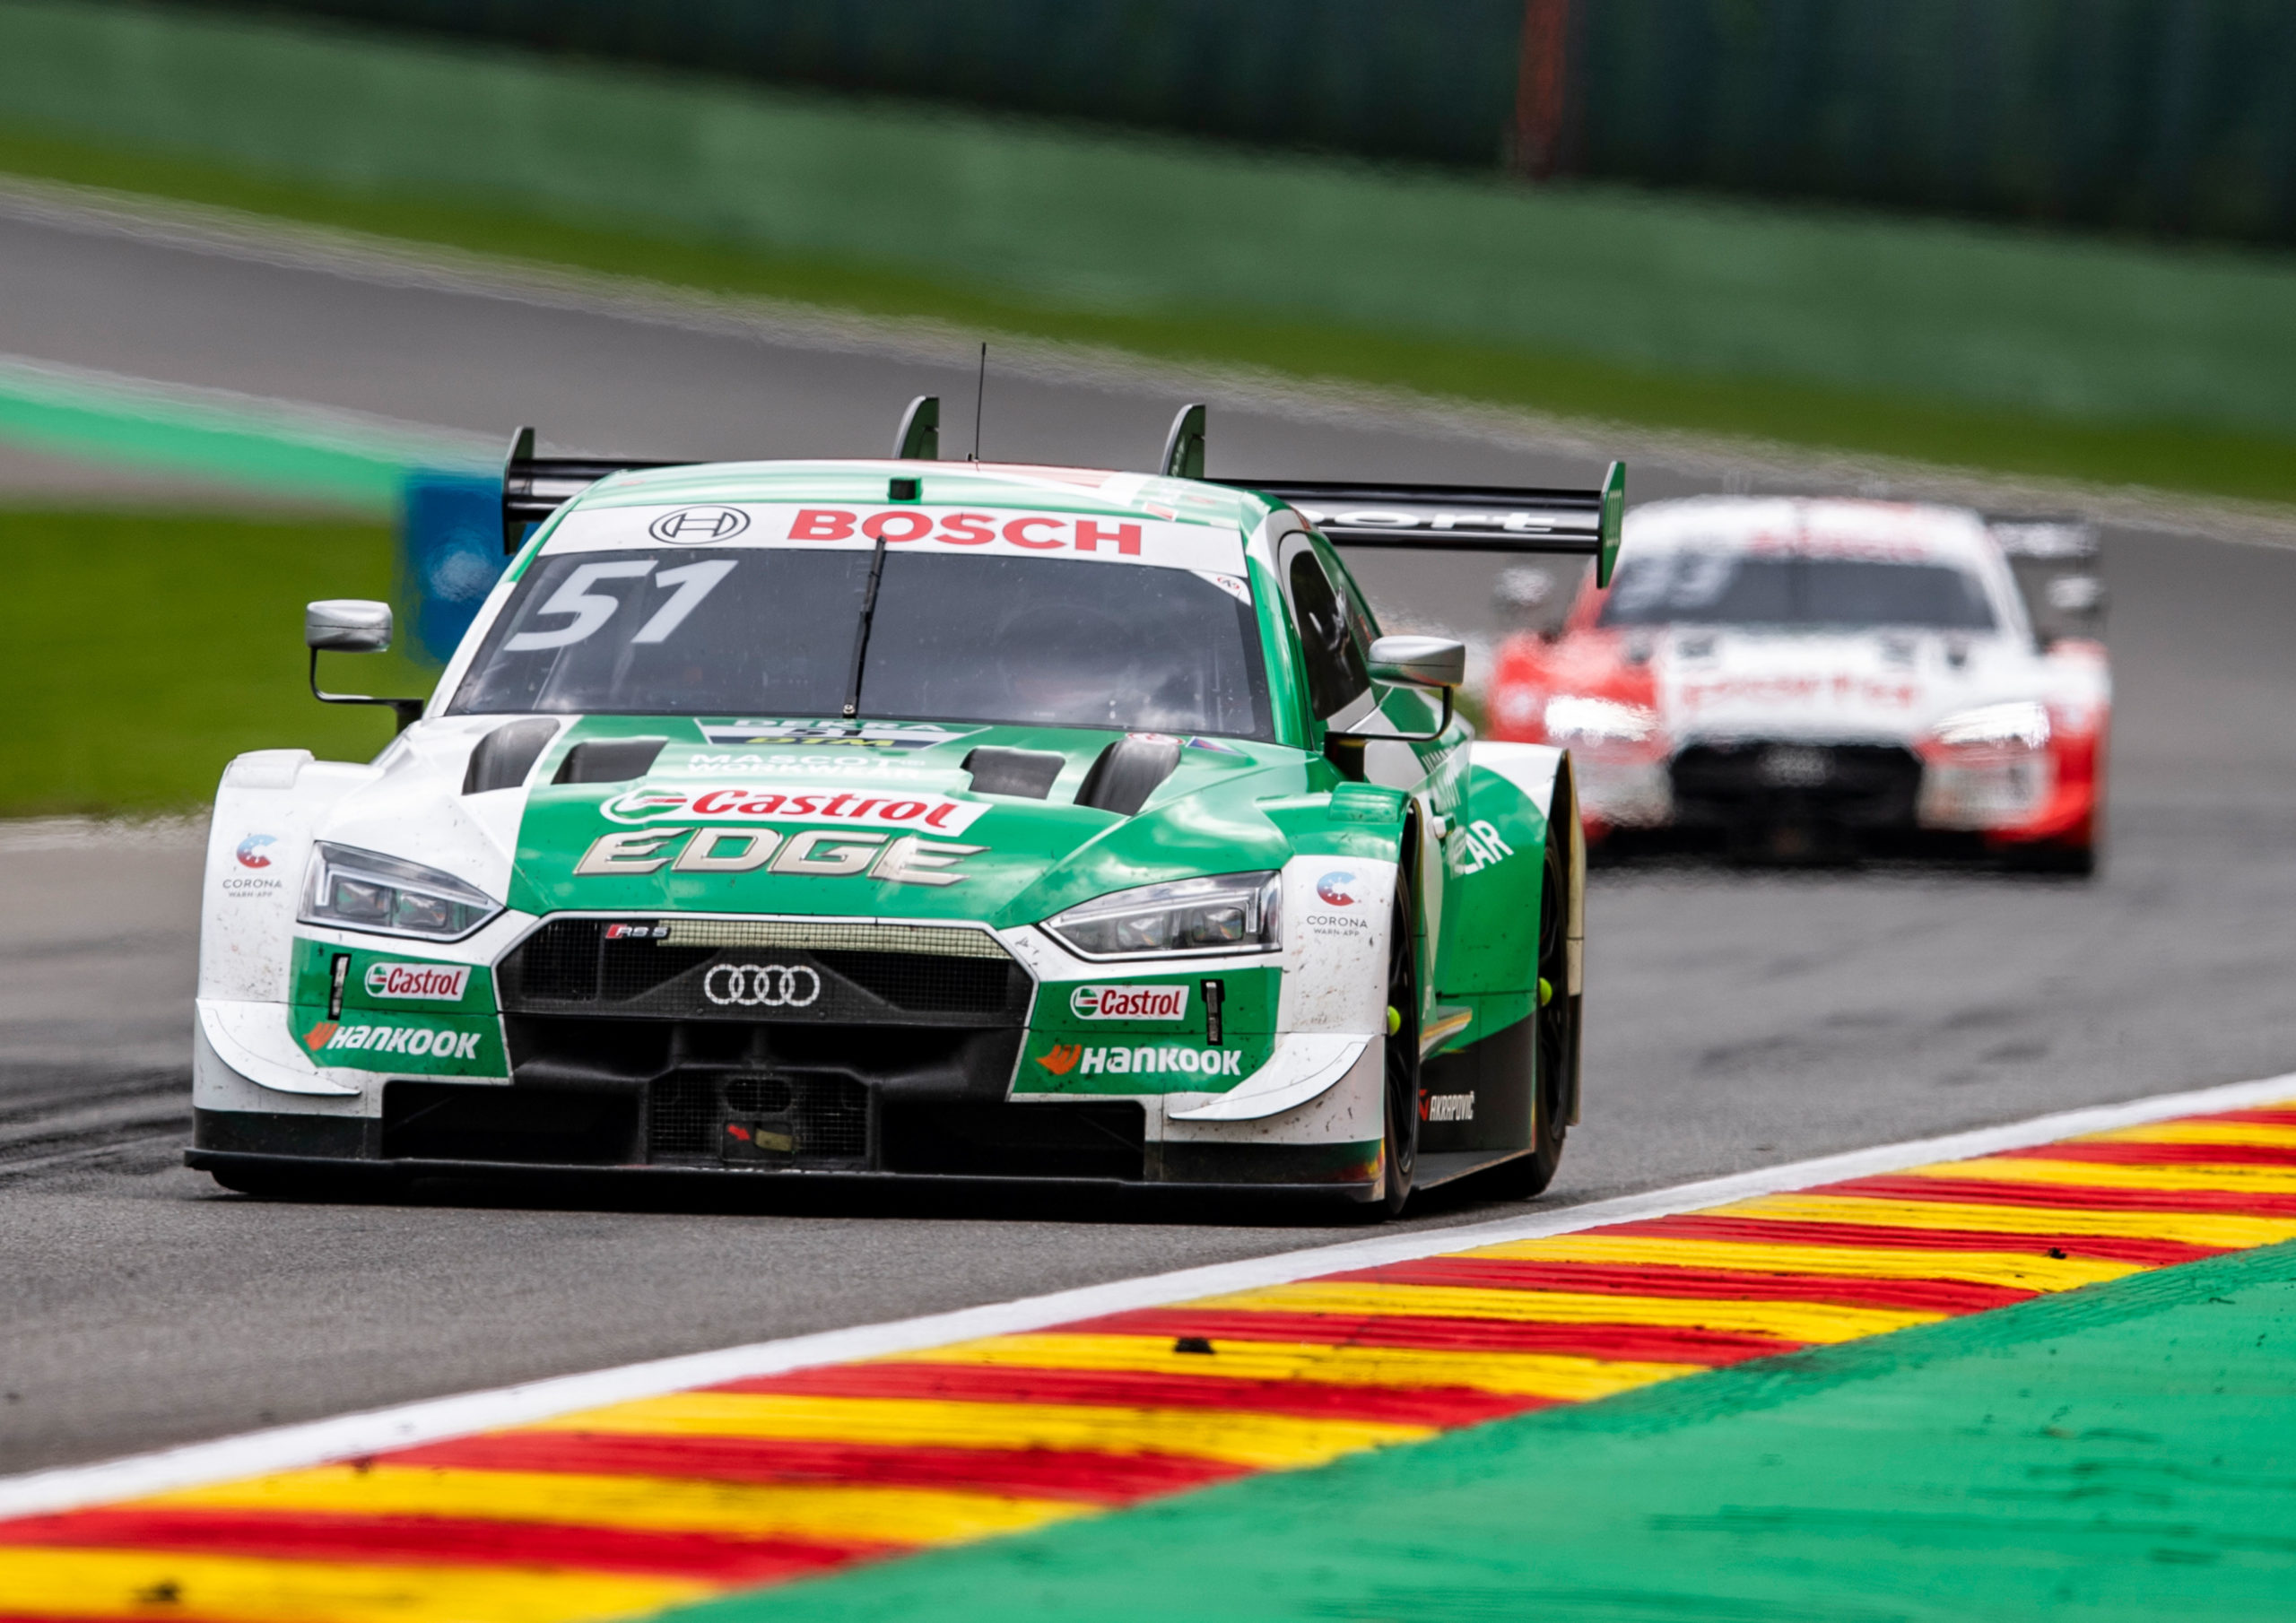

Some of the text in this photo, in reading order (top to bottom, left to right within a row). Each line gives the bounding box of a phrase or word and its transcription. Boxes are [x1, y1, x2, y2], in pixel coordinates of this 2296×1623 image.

[787, 508, 1142, 556] BOSCH
[504, 560, 738, 652] 51
[733, 719, 947, 732] DEKRA
[746, 737, 895, 747] DTM
[689, 754, 900, 768] MASCOT
[692, 788, 959, 829] Castrol
[573, 827, 992, 887] EDGE
[222, 879, 283, 890] CORONA
[1306, 915, 1369, 929] CORONA
[387, 967, 462, 996] Castrol
[1100, 988, 1180, 1016] Castrol
